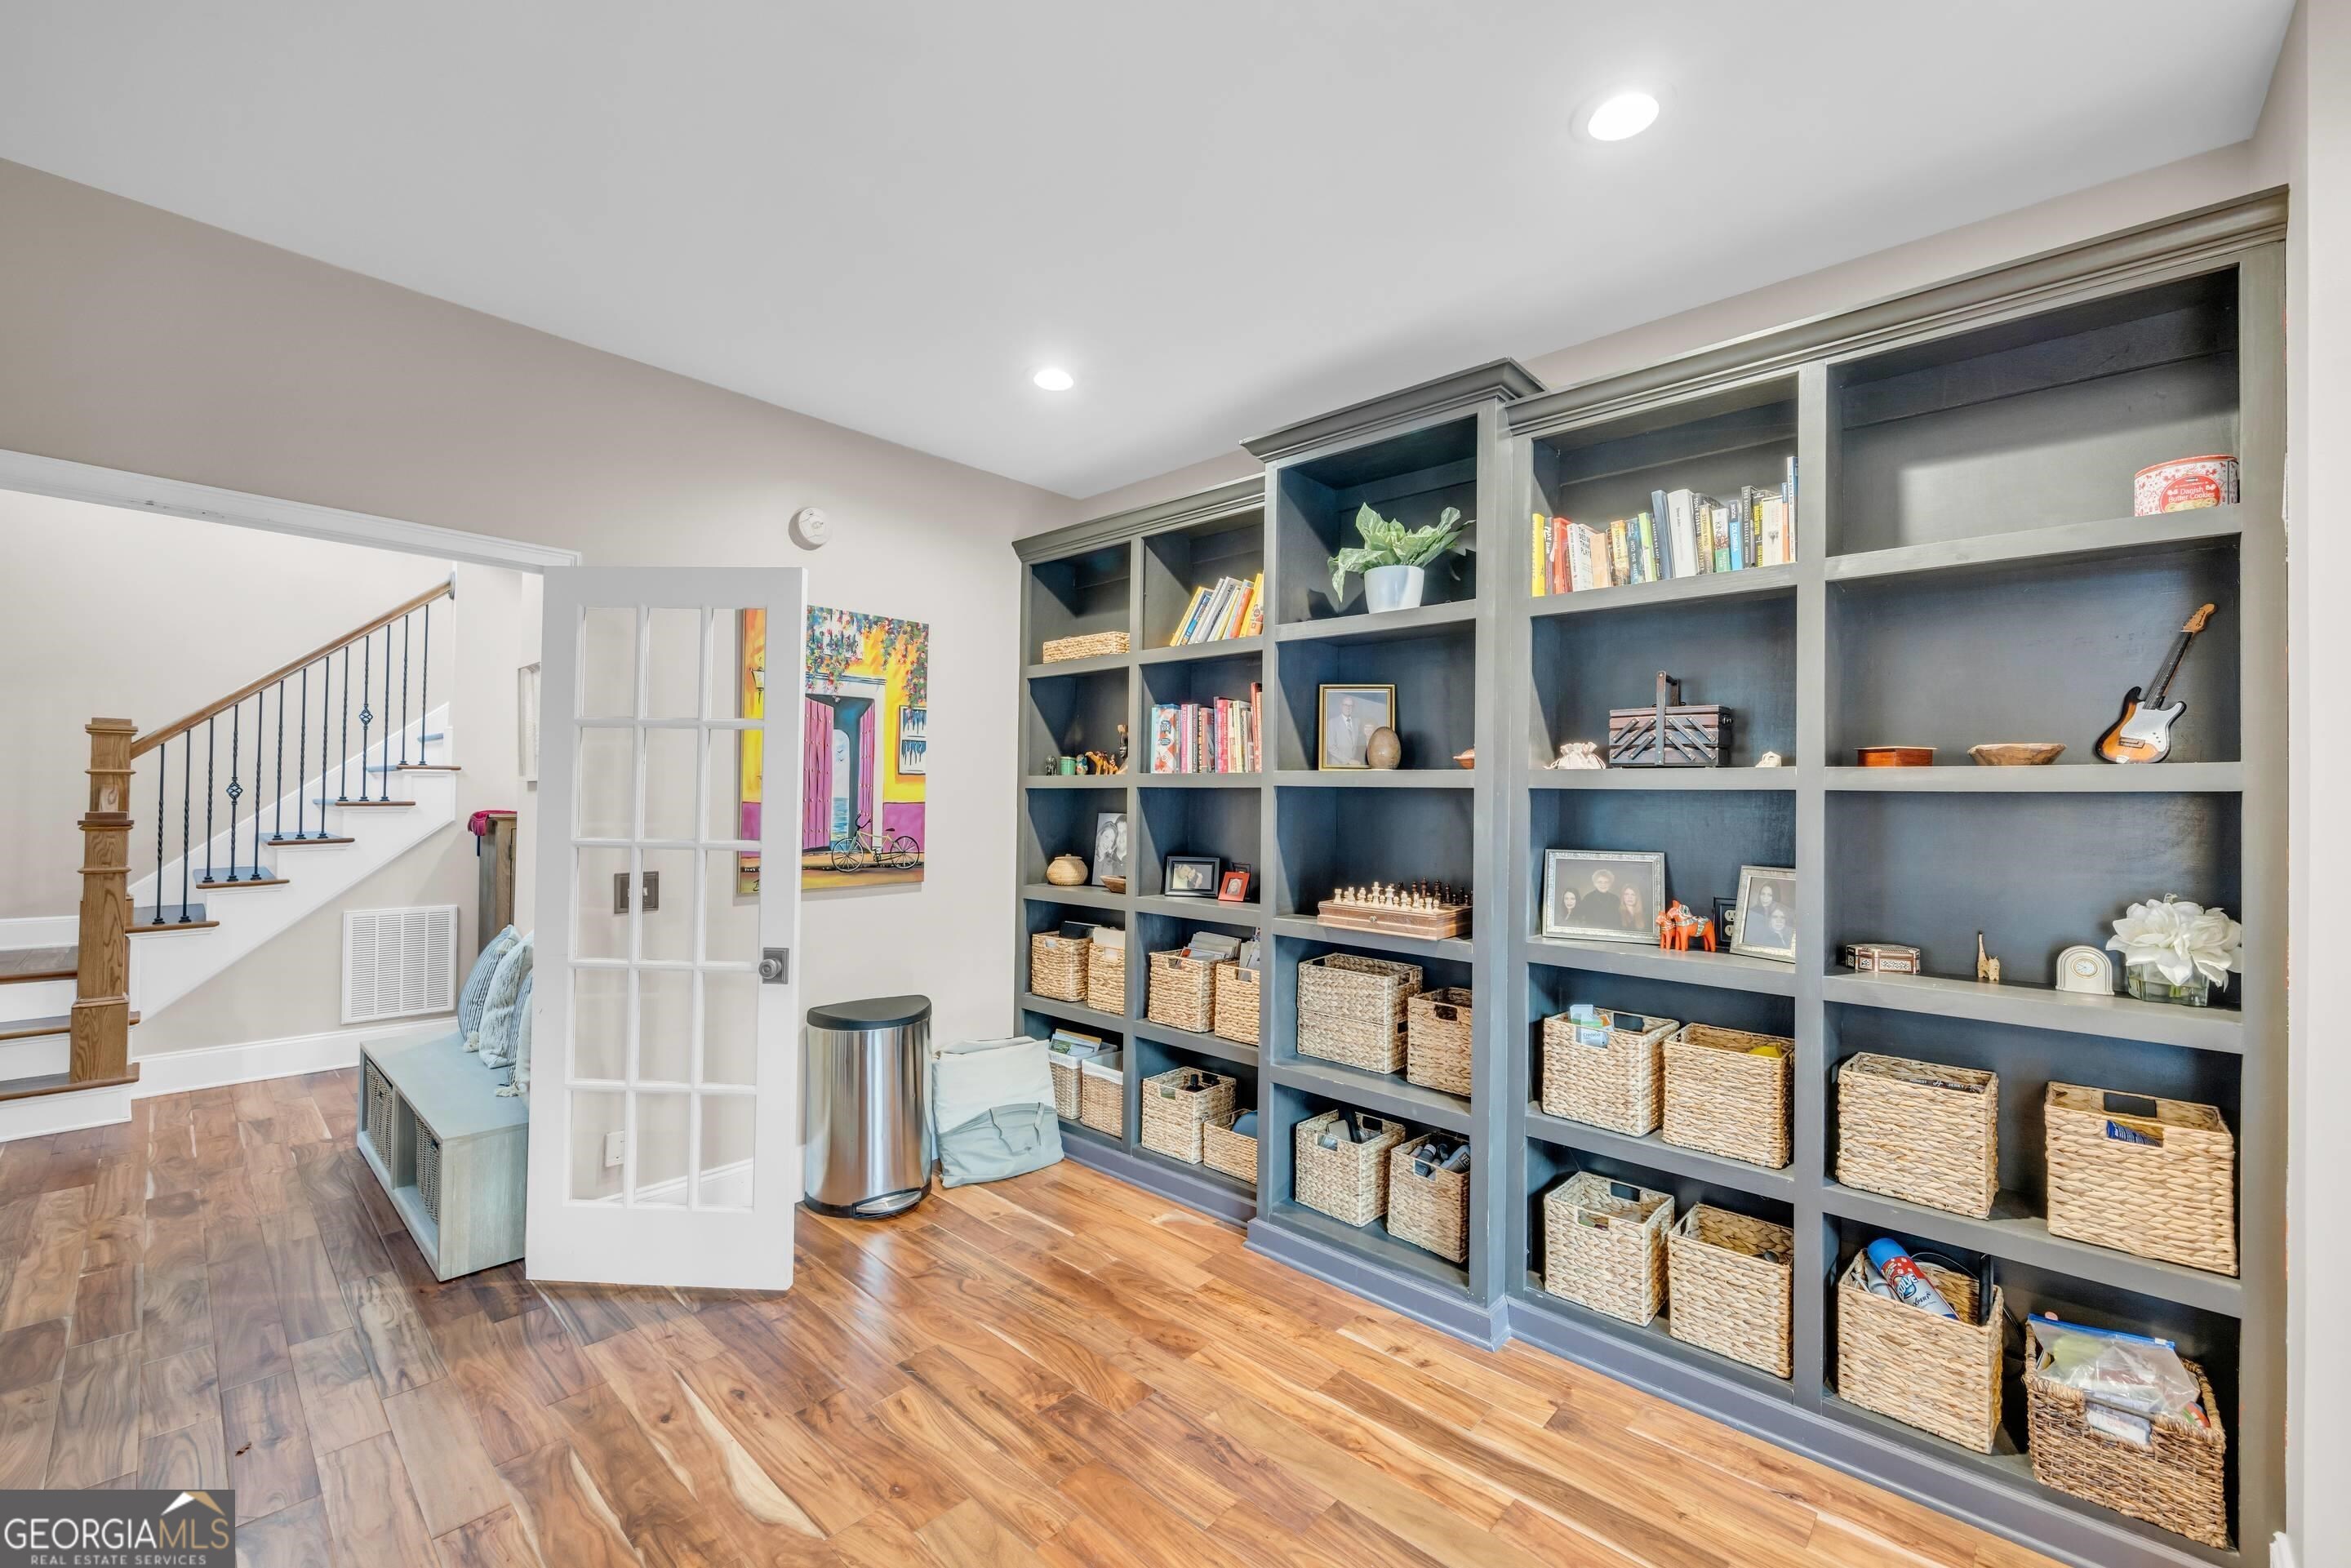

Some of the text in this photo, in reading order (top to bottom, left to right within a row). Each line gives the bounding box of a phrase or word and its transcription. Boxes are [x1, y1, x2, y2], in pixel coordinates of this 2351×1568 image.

[2180, 486, 2203, 495] Danish
[1544, 526, 1553, 541] PLAY
[1715, 522, 1723, 539] KING
